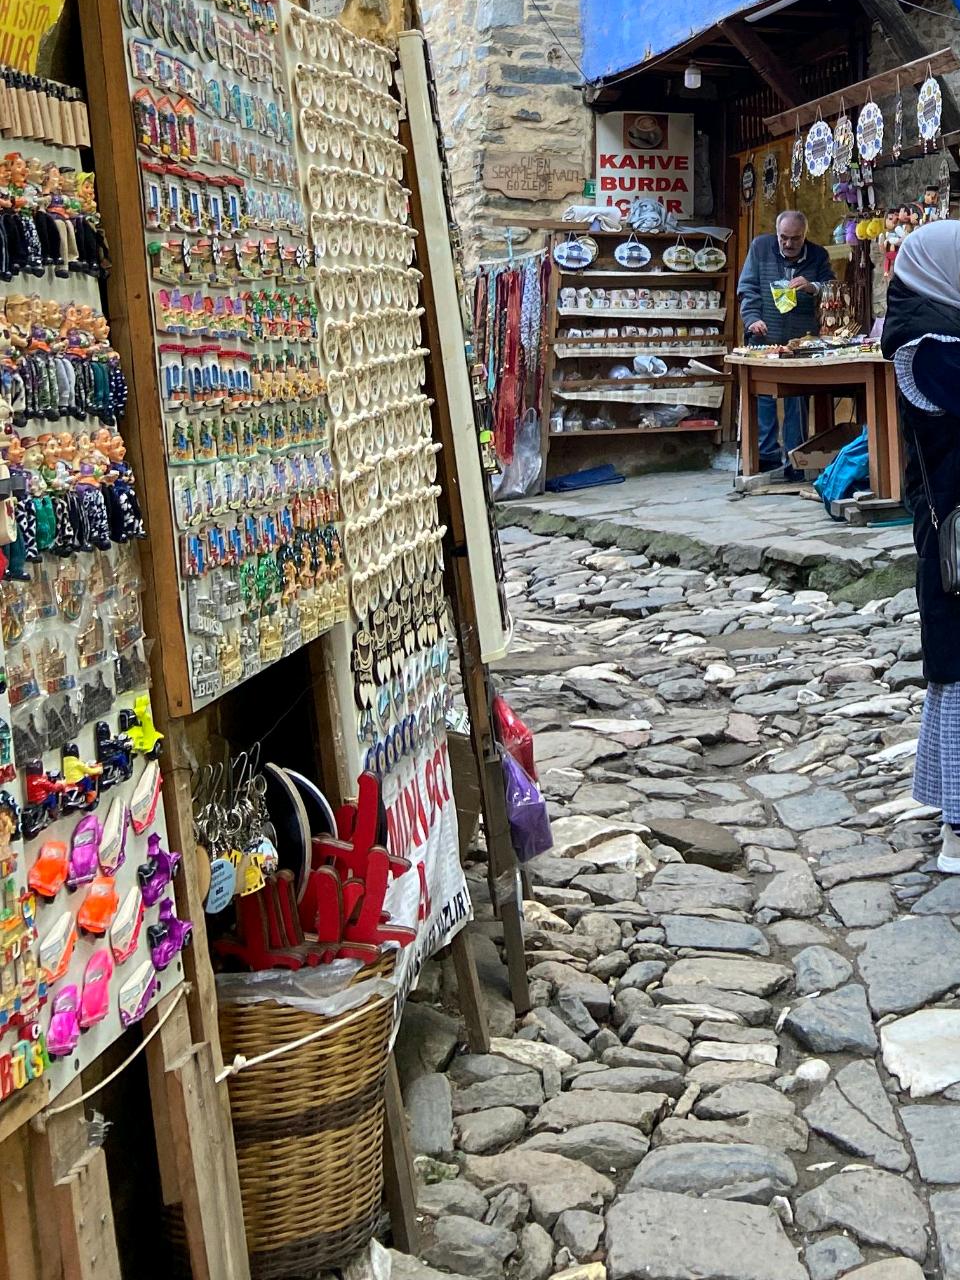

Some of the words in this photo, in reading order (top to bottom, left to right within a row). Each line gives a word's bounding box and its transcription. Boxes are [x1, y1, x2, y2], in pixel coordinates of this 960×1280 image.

[600, 154, 689, 170] KAHVE
[601, 177, 688, 192] BURDA
[606, 195, 683, 217] İÇR
